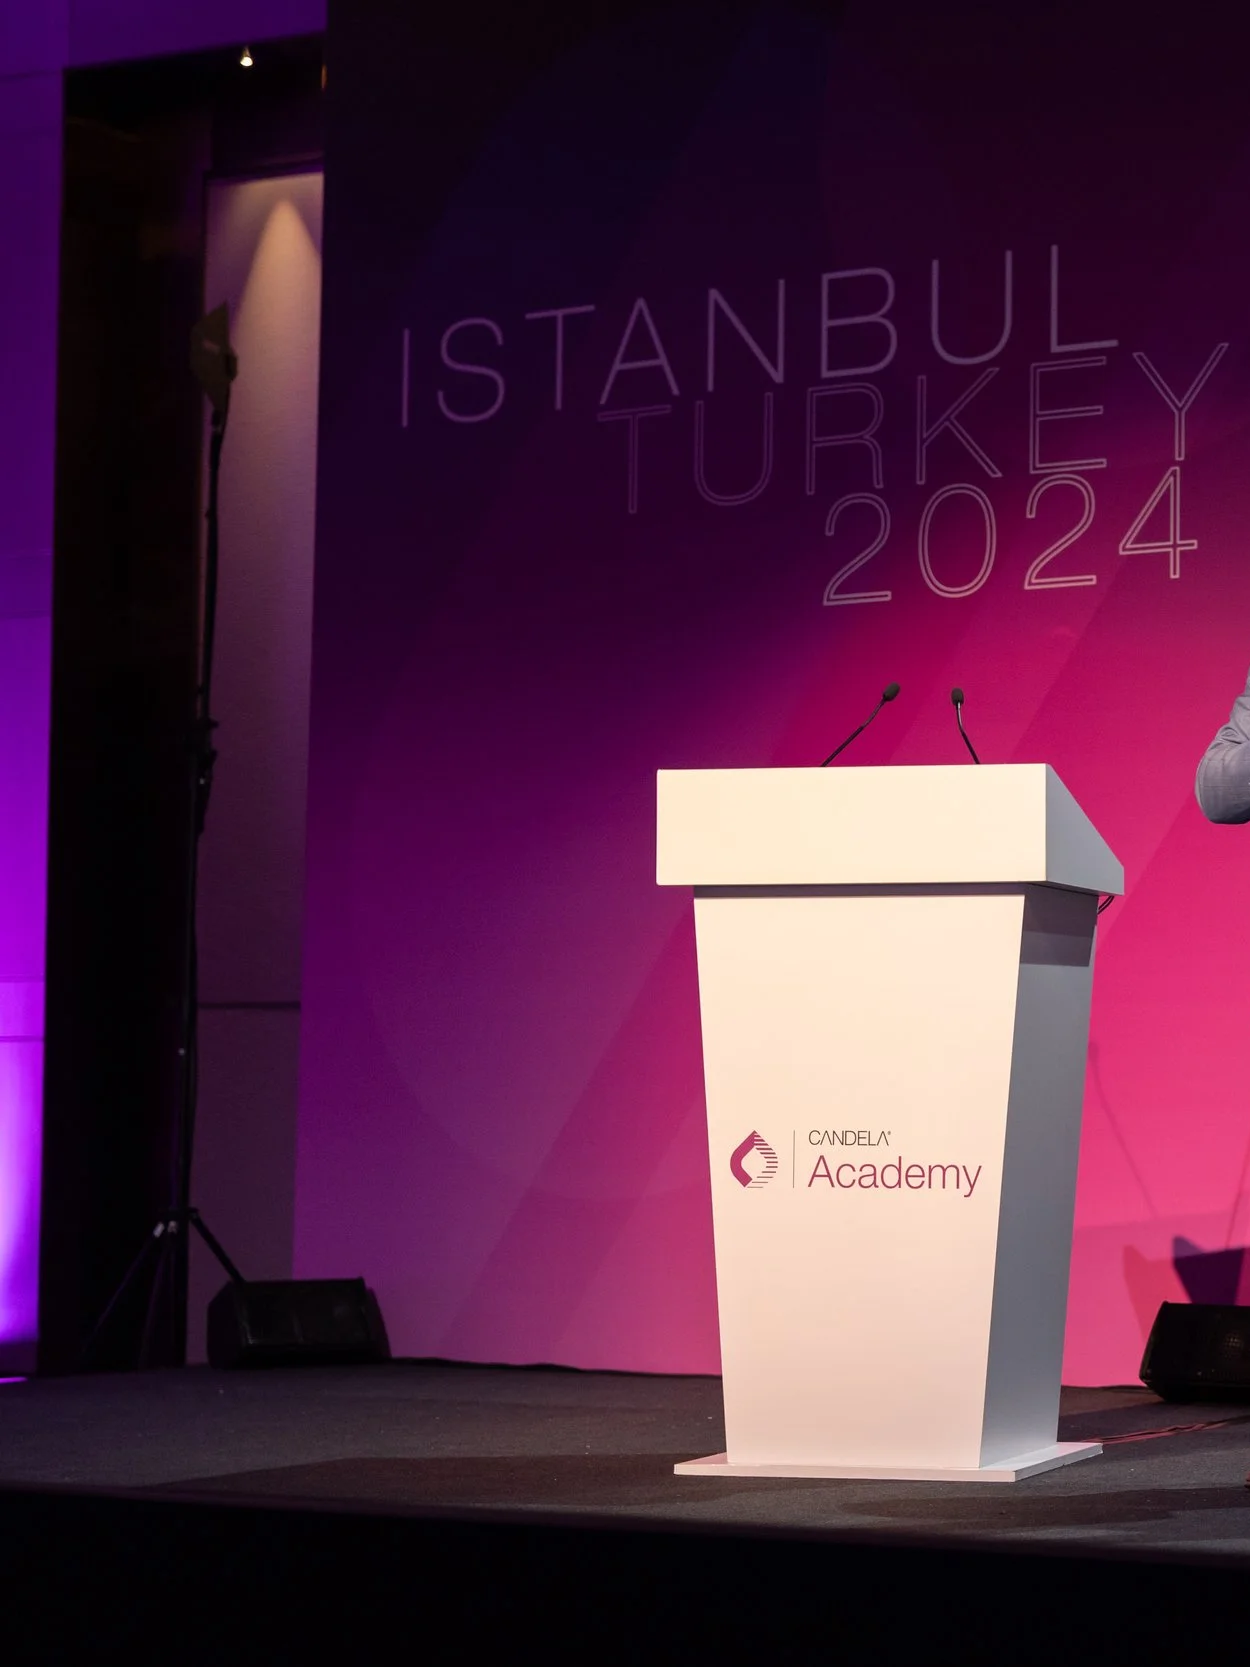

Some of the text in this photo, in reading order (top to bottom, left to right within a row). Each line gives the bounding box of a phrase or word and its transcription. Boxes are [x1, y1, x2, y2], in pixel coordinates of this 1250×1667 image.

[400, 245, 1118, 427] ISTANBUL
[597, 343, 1229, 513] TURKEY
[823, 466, 1198, 605] 2024
[807, 1155, 982, 1198] Academy
